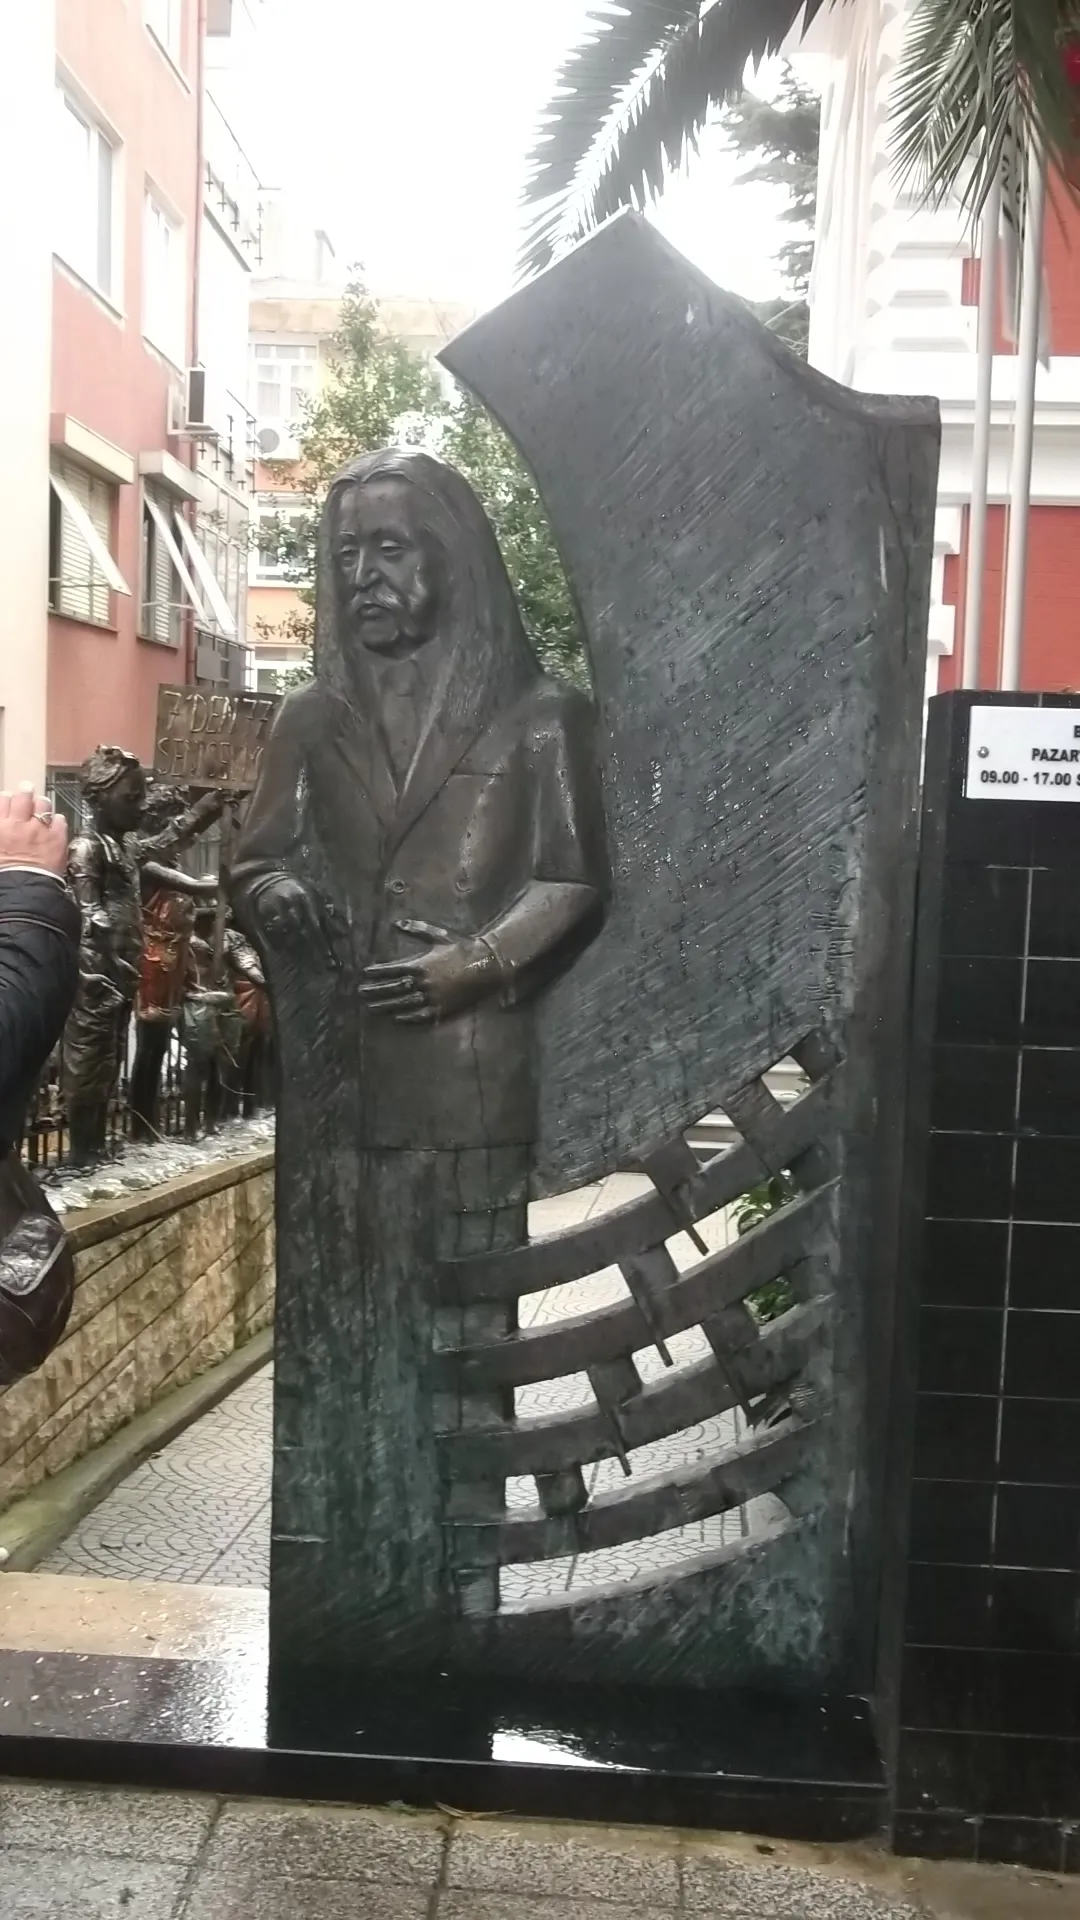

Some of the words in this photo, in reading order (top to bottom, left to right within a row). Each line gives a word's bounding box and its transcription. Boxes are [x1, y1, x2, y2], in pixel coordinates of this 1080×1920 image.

[1031, 748, 1080, 762] PAZAR
[980, 770, 1019, 784] 09.00
[1033, 772, 1071, 786] 17.00
